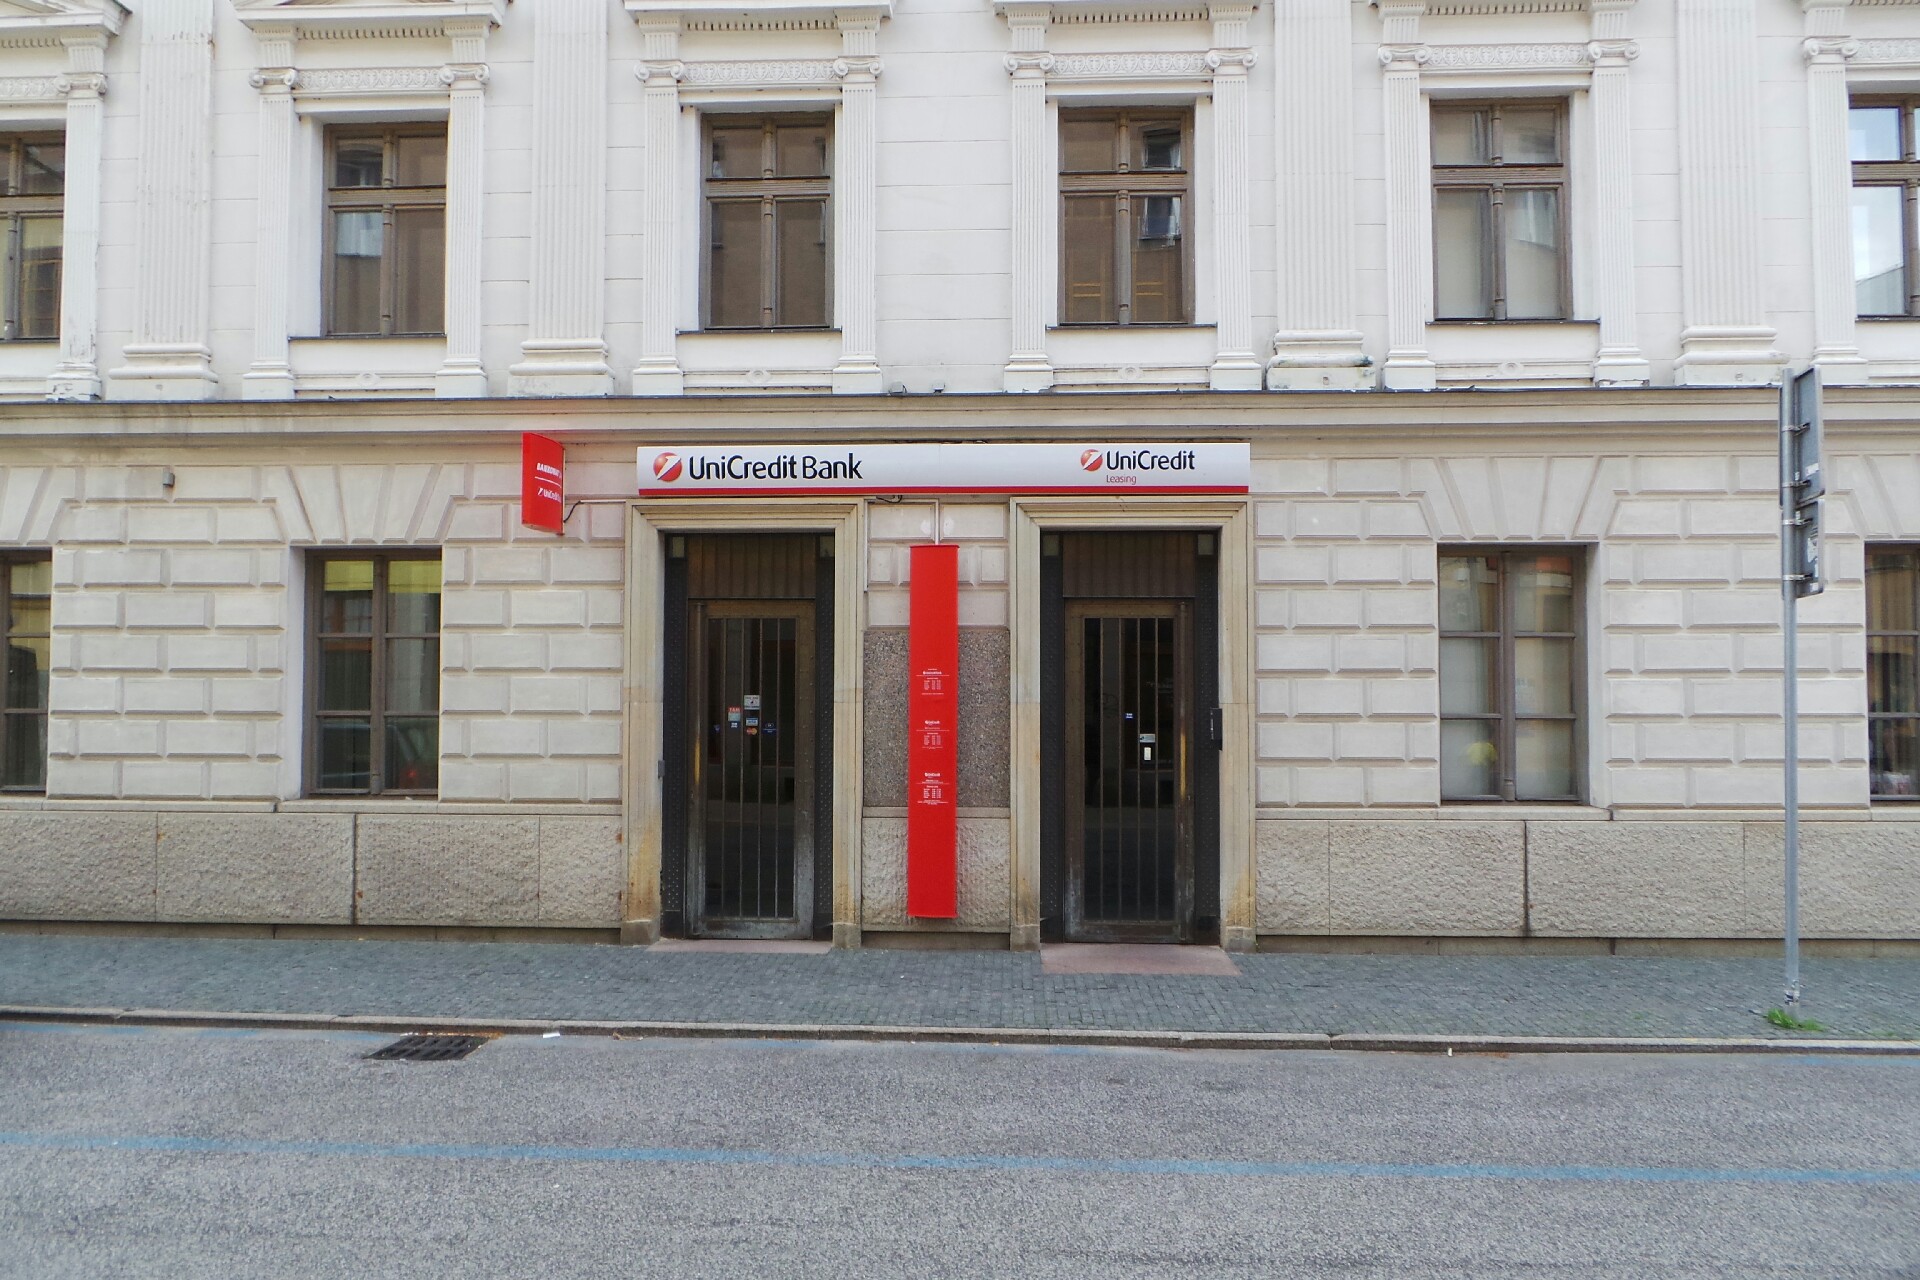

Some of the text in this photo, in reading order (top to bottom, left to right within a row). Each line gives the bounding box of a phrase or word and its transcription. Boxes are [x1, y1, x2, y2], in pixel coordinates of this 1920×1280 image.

[689, 452, 863, 480] UniCredit Bank
[1106, 450, 1195, 471] UniCredit
[1106, 475, 1137, 485] Leasing
